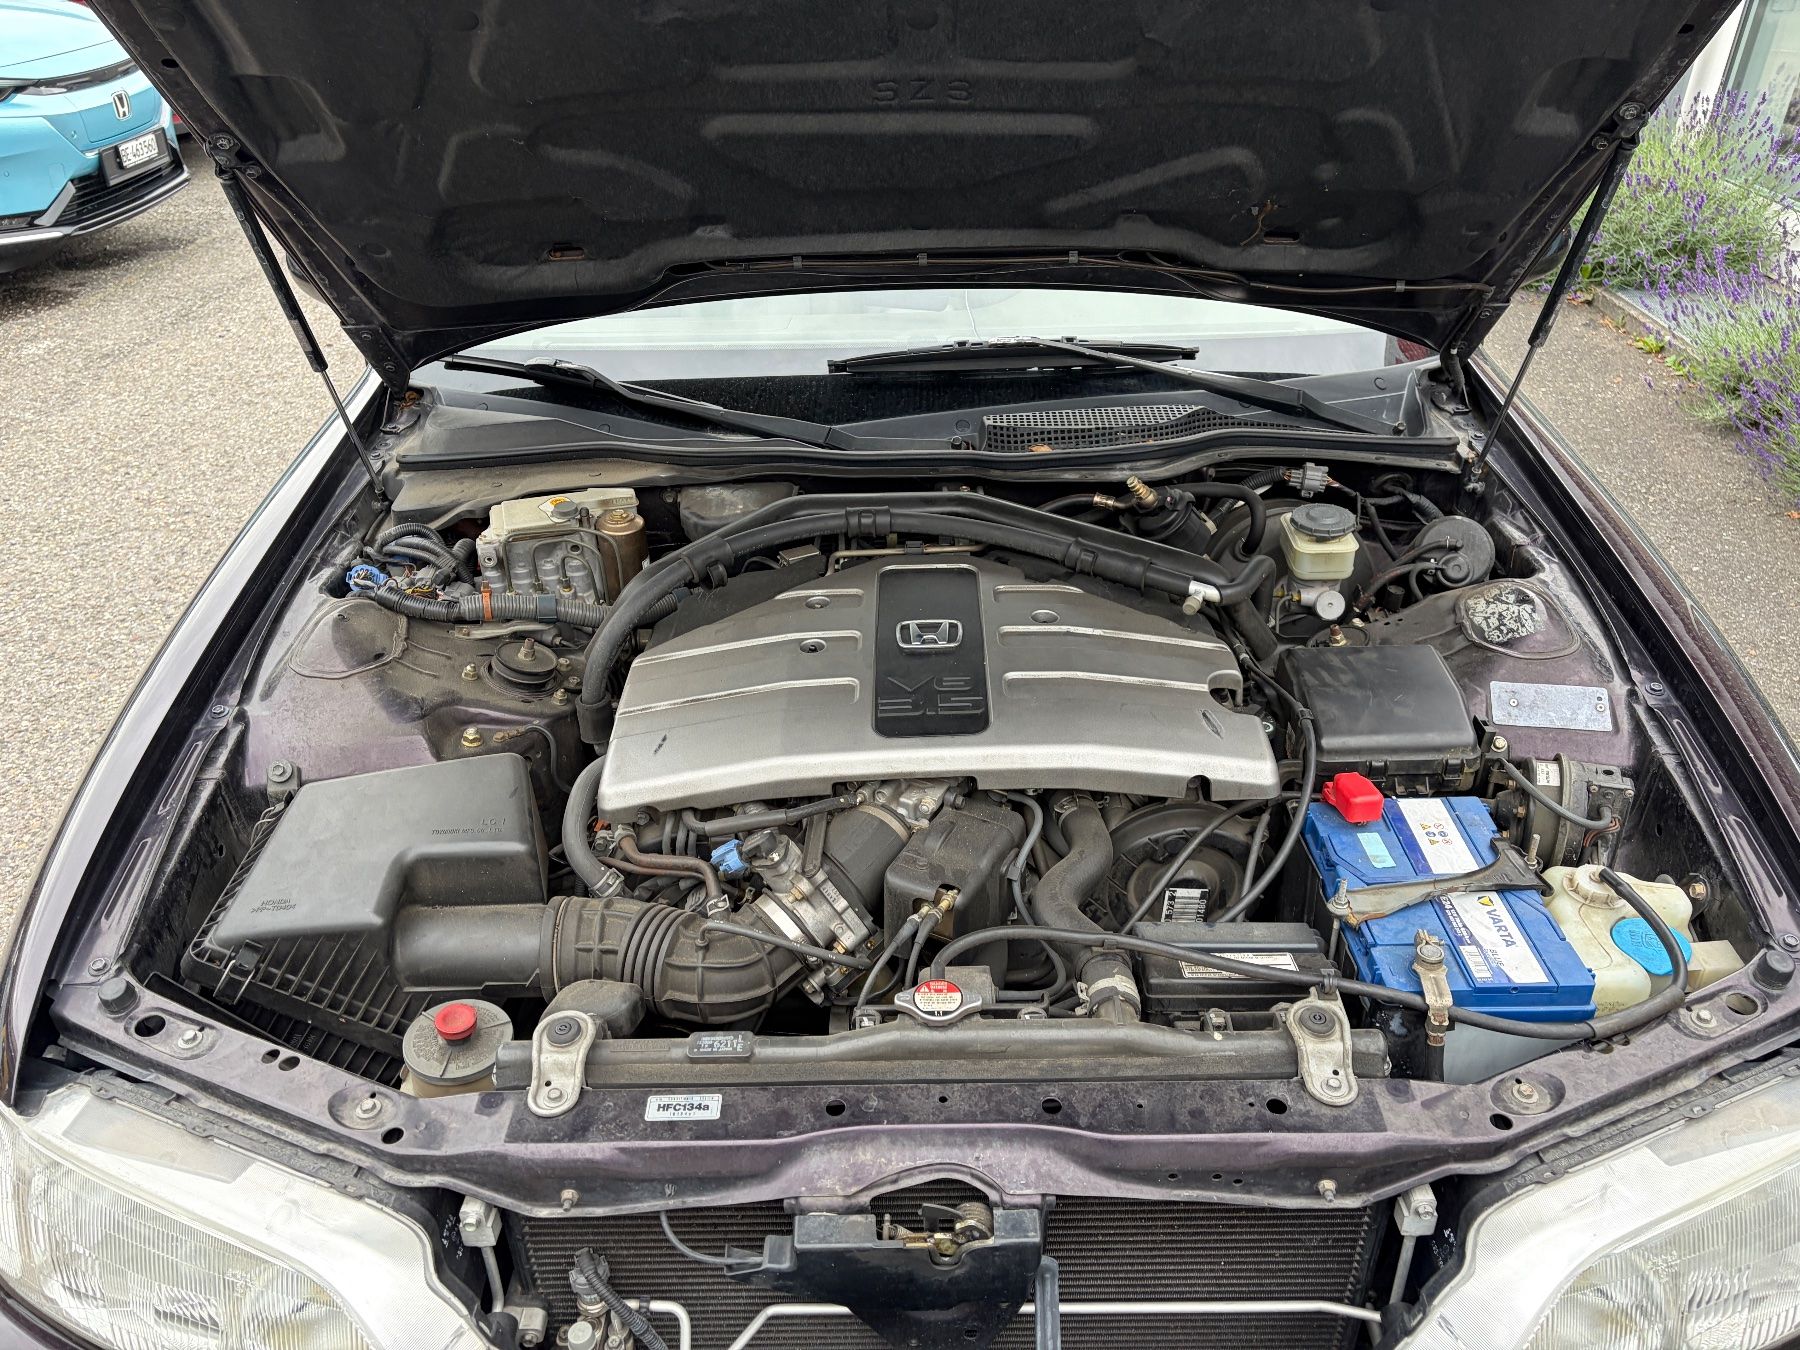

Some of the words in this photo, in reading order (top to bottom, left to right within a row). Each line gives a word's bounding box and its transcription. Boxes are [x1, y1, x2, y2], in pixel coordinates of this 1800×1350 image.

[887, 675, 974, 692] V6
[877, 694, 985, 717] 3.5
[1486, 908, 1517, 948] VARTA
[656, 1102, 711, 1113] HFC134a
